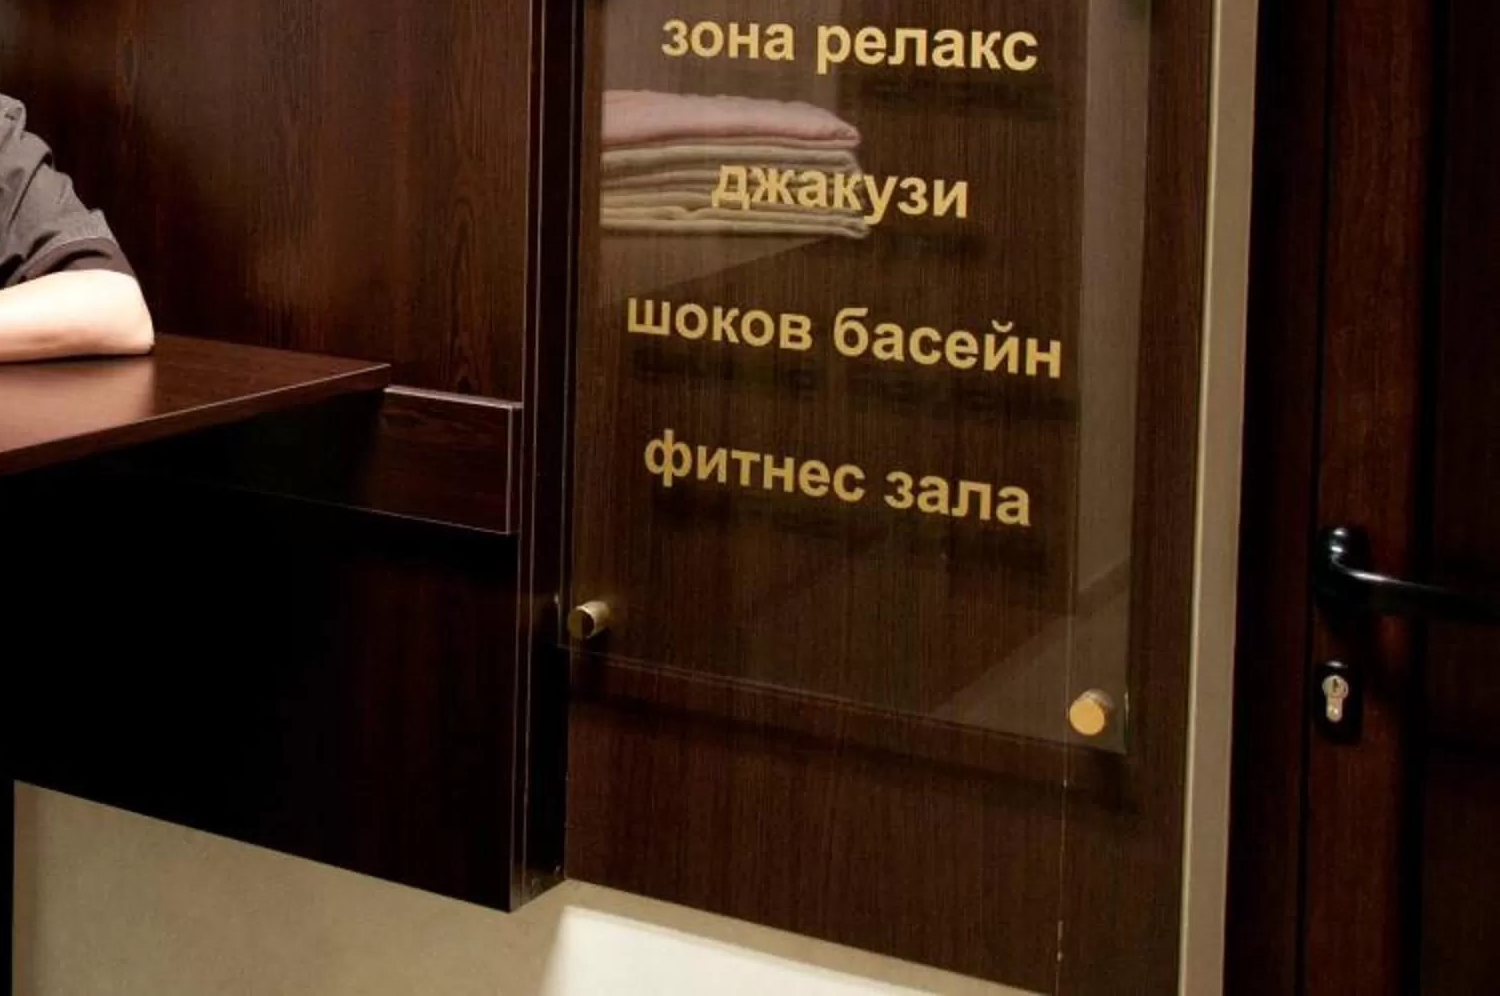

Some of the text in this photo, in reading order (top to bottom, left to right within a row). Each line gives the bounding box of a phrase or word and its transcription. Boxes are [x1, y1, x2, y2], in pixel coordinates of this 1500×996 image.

[660, 18, 1038, 76] зона релакс
[710, 164, 969, 225] джакузи
[627, 297, 1061, 378] шоков басейн
[645, 429, 1029, 526] фитнес зала
